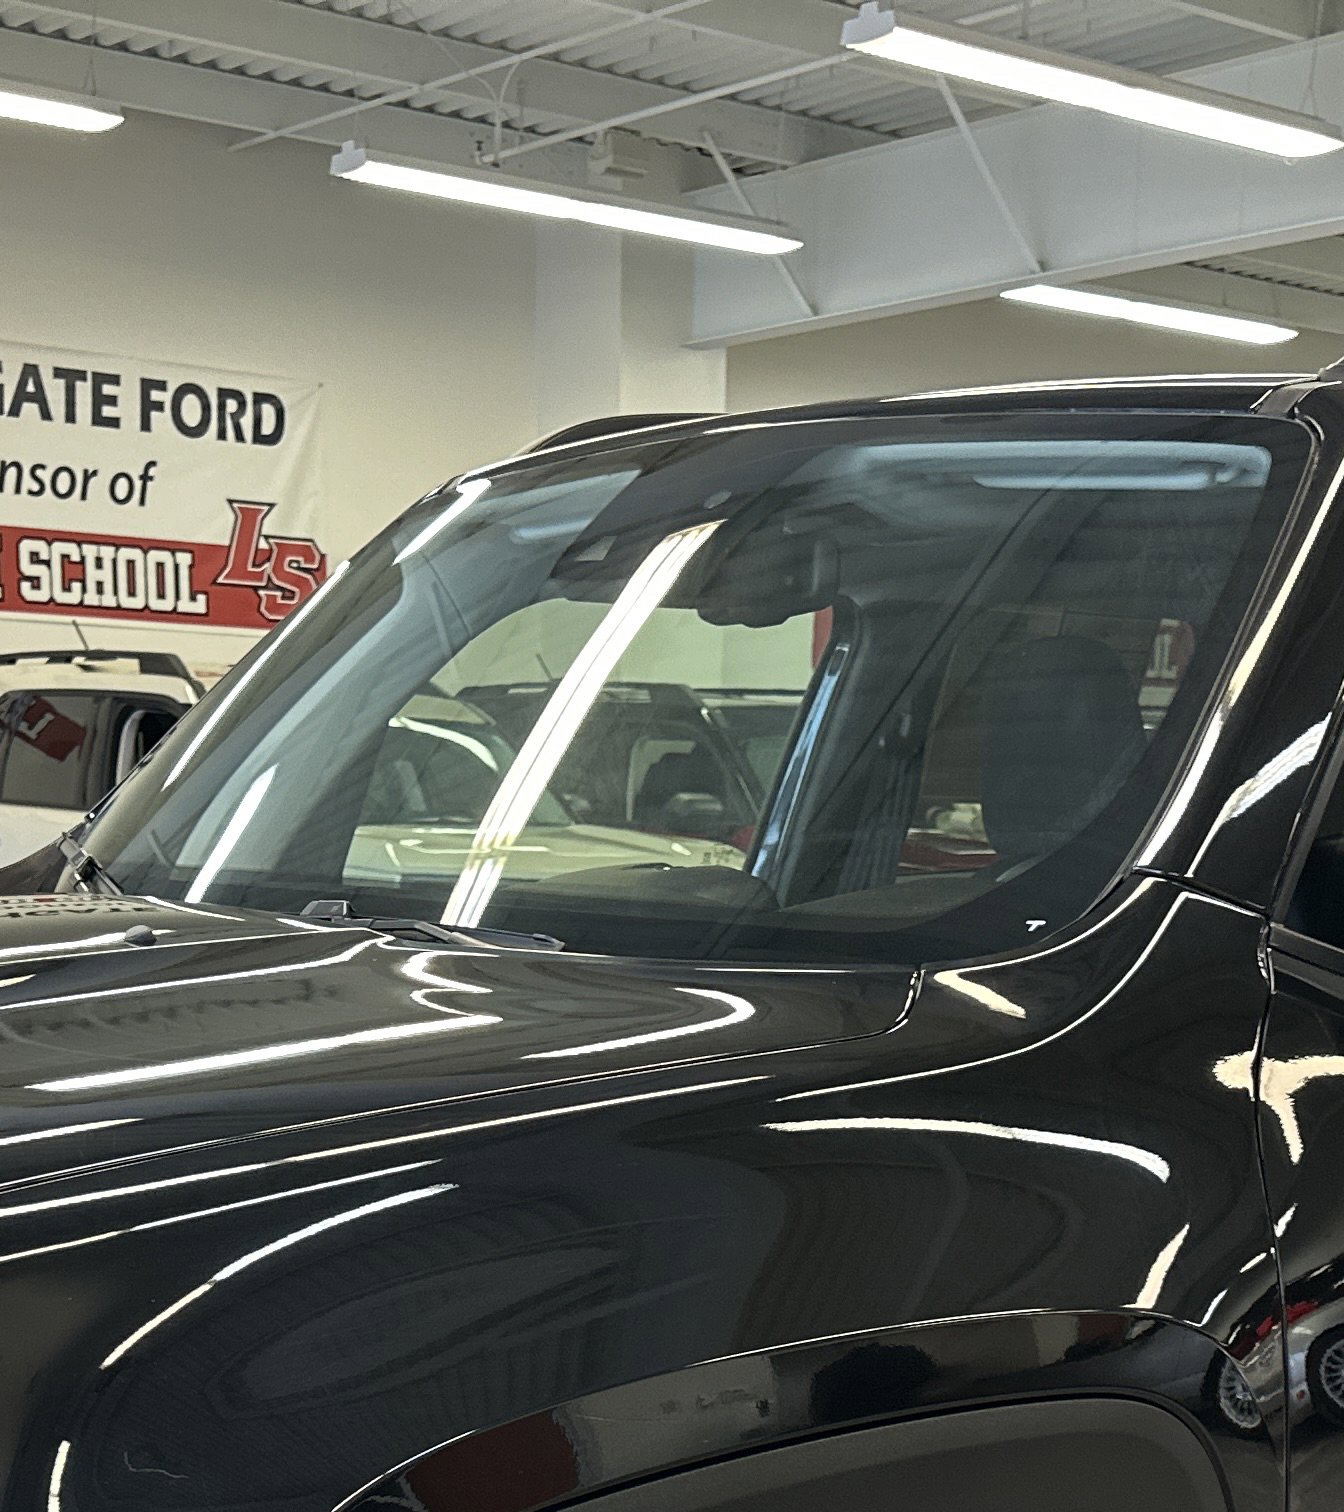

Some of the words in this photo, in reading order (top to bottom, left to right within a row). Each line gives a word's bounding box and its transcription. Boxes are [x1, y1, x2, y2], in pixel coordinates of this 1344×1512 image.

[139, 376, 286, 447] FORD
[108, 461, 158, 507] of
[17, 537, 209, 616] SCHOOL
[212, 498, 324, 622] LS
